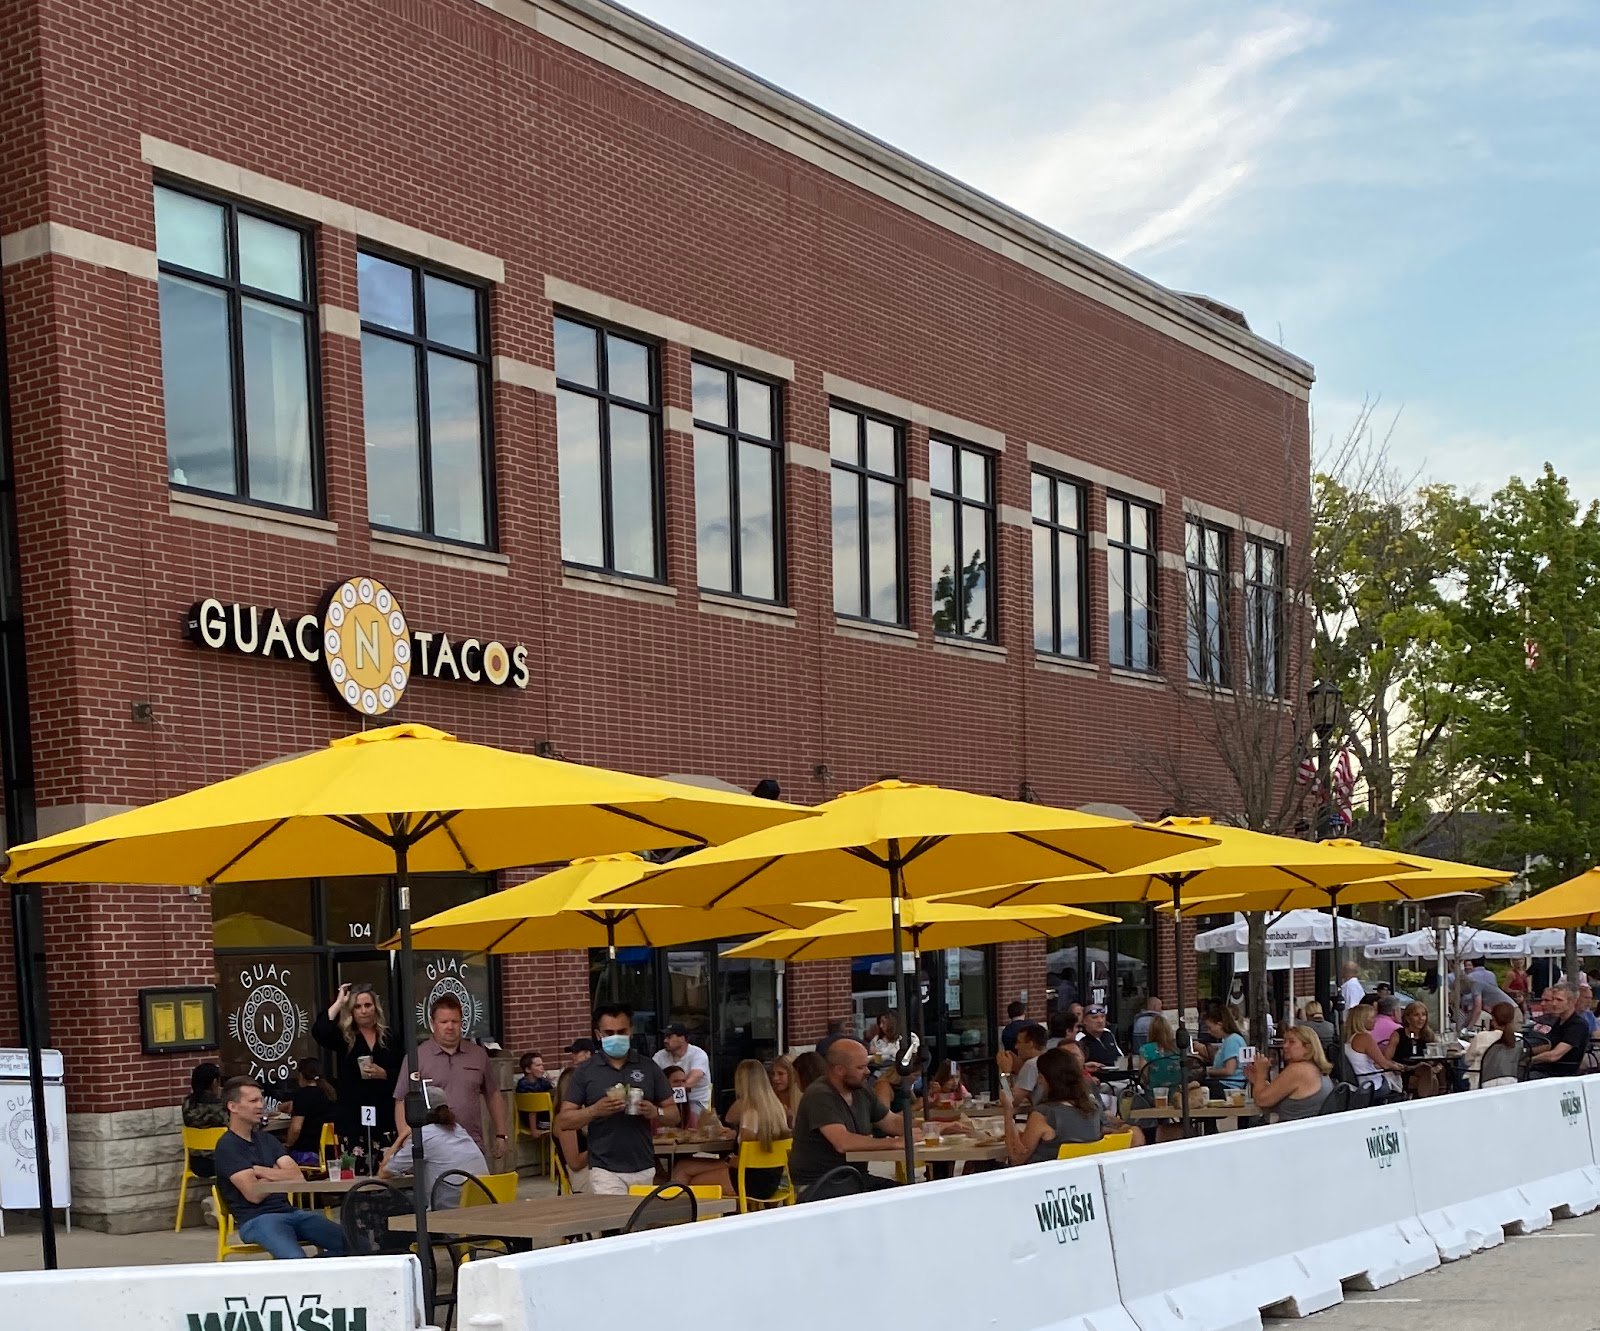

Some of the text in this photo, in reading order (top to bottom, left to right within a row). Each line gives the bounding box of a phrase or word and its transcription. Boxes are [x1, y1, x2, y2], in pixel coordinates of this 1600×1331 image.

[199, 598, 529, 689] GUAC N TACOS
[348, 922, 372, 938] 104
[1266, 930, 1298, 940] ombacher
[240, 963, 291, 989] GUAC
[426, 957, 469, 981] GUAC
[263, 1013, 276, 1033] N
[1243, 1048, 1252, 1059] 11
[248, 1056, 298, 1085] TACOS
[674, 1088, 685, 1099] 20
[6, 1096, 33, 1112] GU
[365, 1108, 371, 1121] 2
[24, 1128, 33, 1141] N
[1366, 1131, 1400, 1159] WALSH
[1034, 1192, 1095, 1232] WALSH
